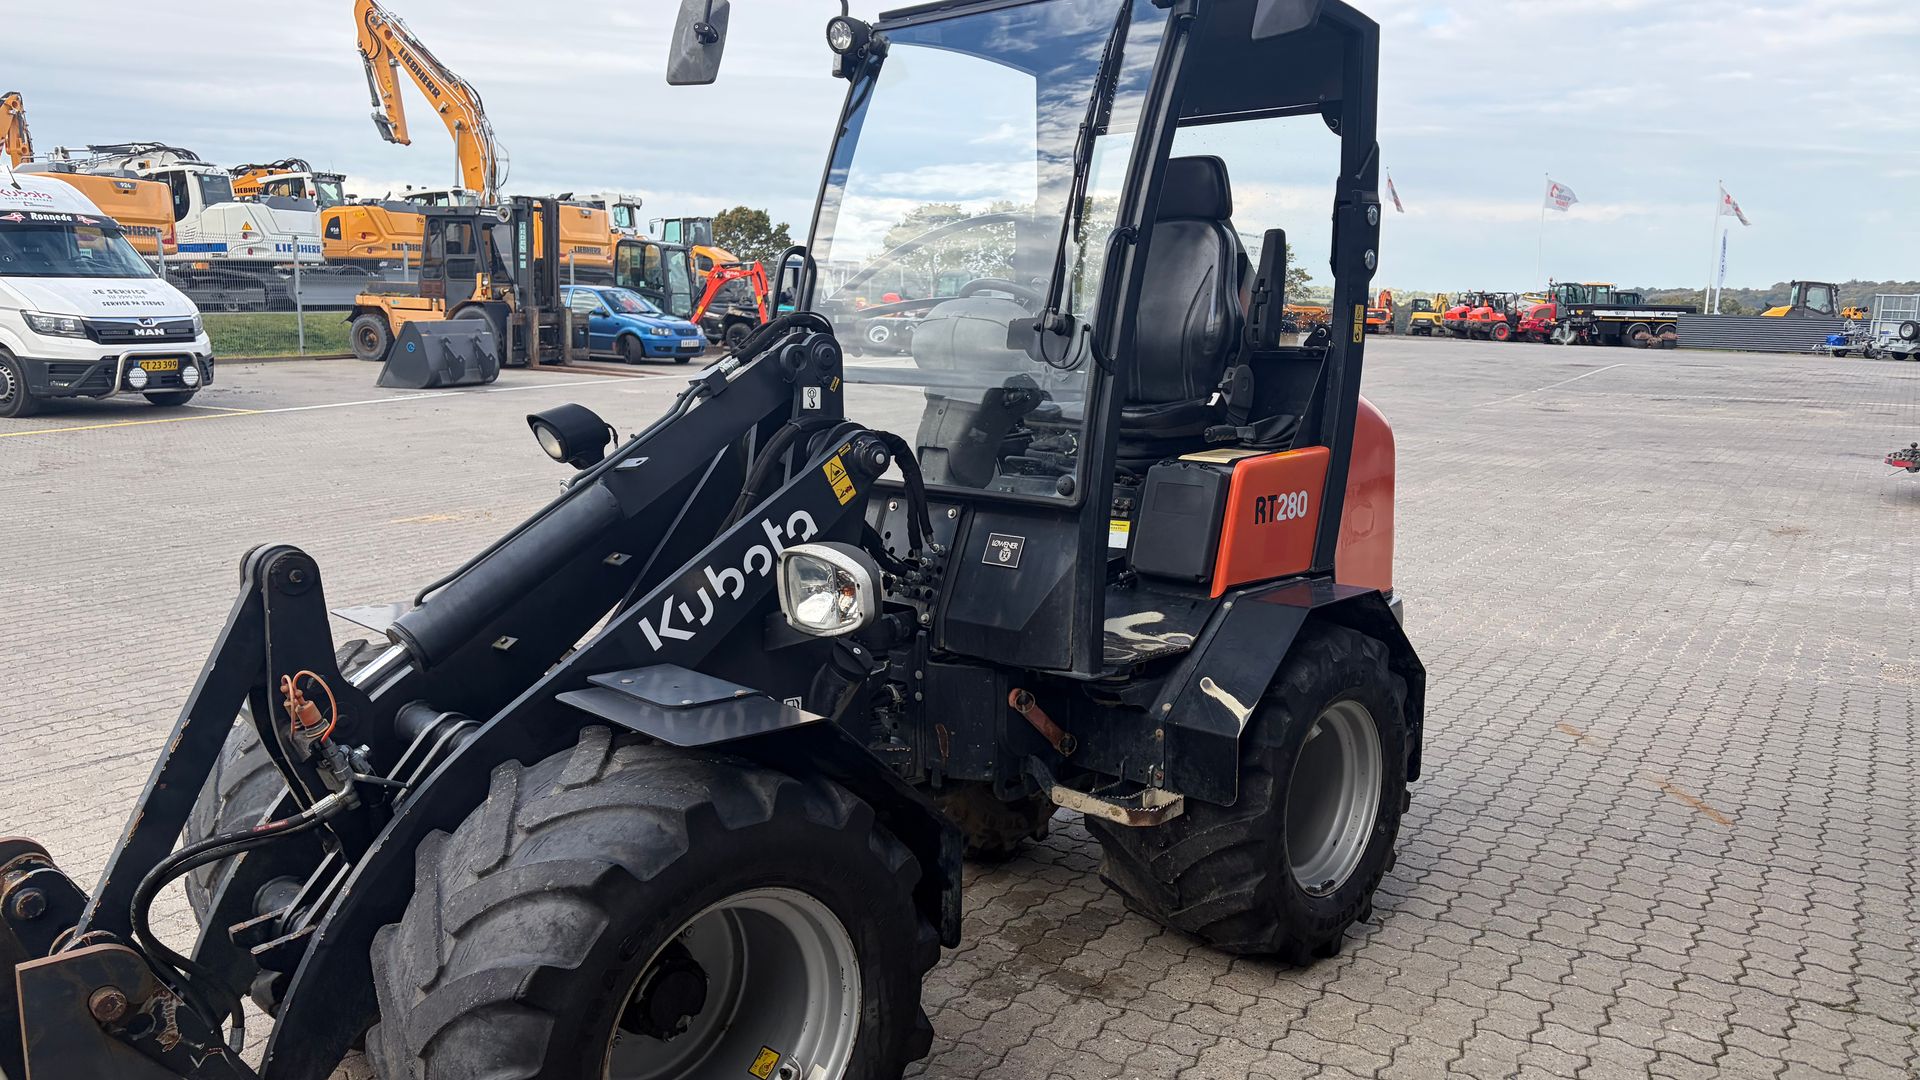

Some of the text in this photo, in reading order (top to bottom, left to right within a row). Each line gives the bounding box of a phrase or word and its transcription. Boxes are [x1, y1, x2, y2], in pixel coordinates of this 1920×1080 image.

[398, 46, 441, 99] LIEBHERR
[234, 186, 264, 194] LIEBHER
[275, 243, 321, 254] LIEHERR
[574, 245, 602, 255] LIEBHERR
[134, 328, 165, 336] MAN
[152, 361, 163, 369] 23
[163, 360, 177, 369] 399
[1255, 490, 1308, 525] RT280
[638, 510, 819, 652] Kubota
